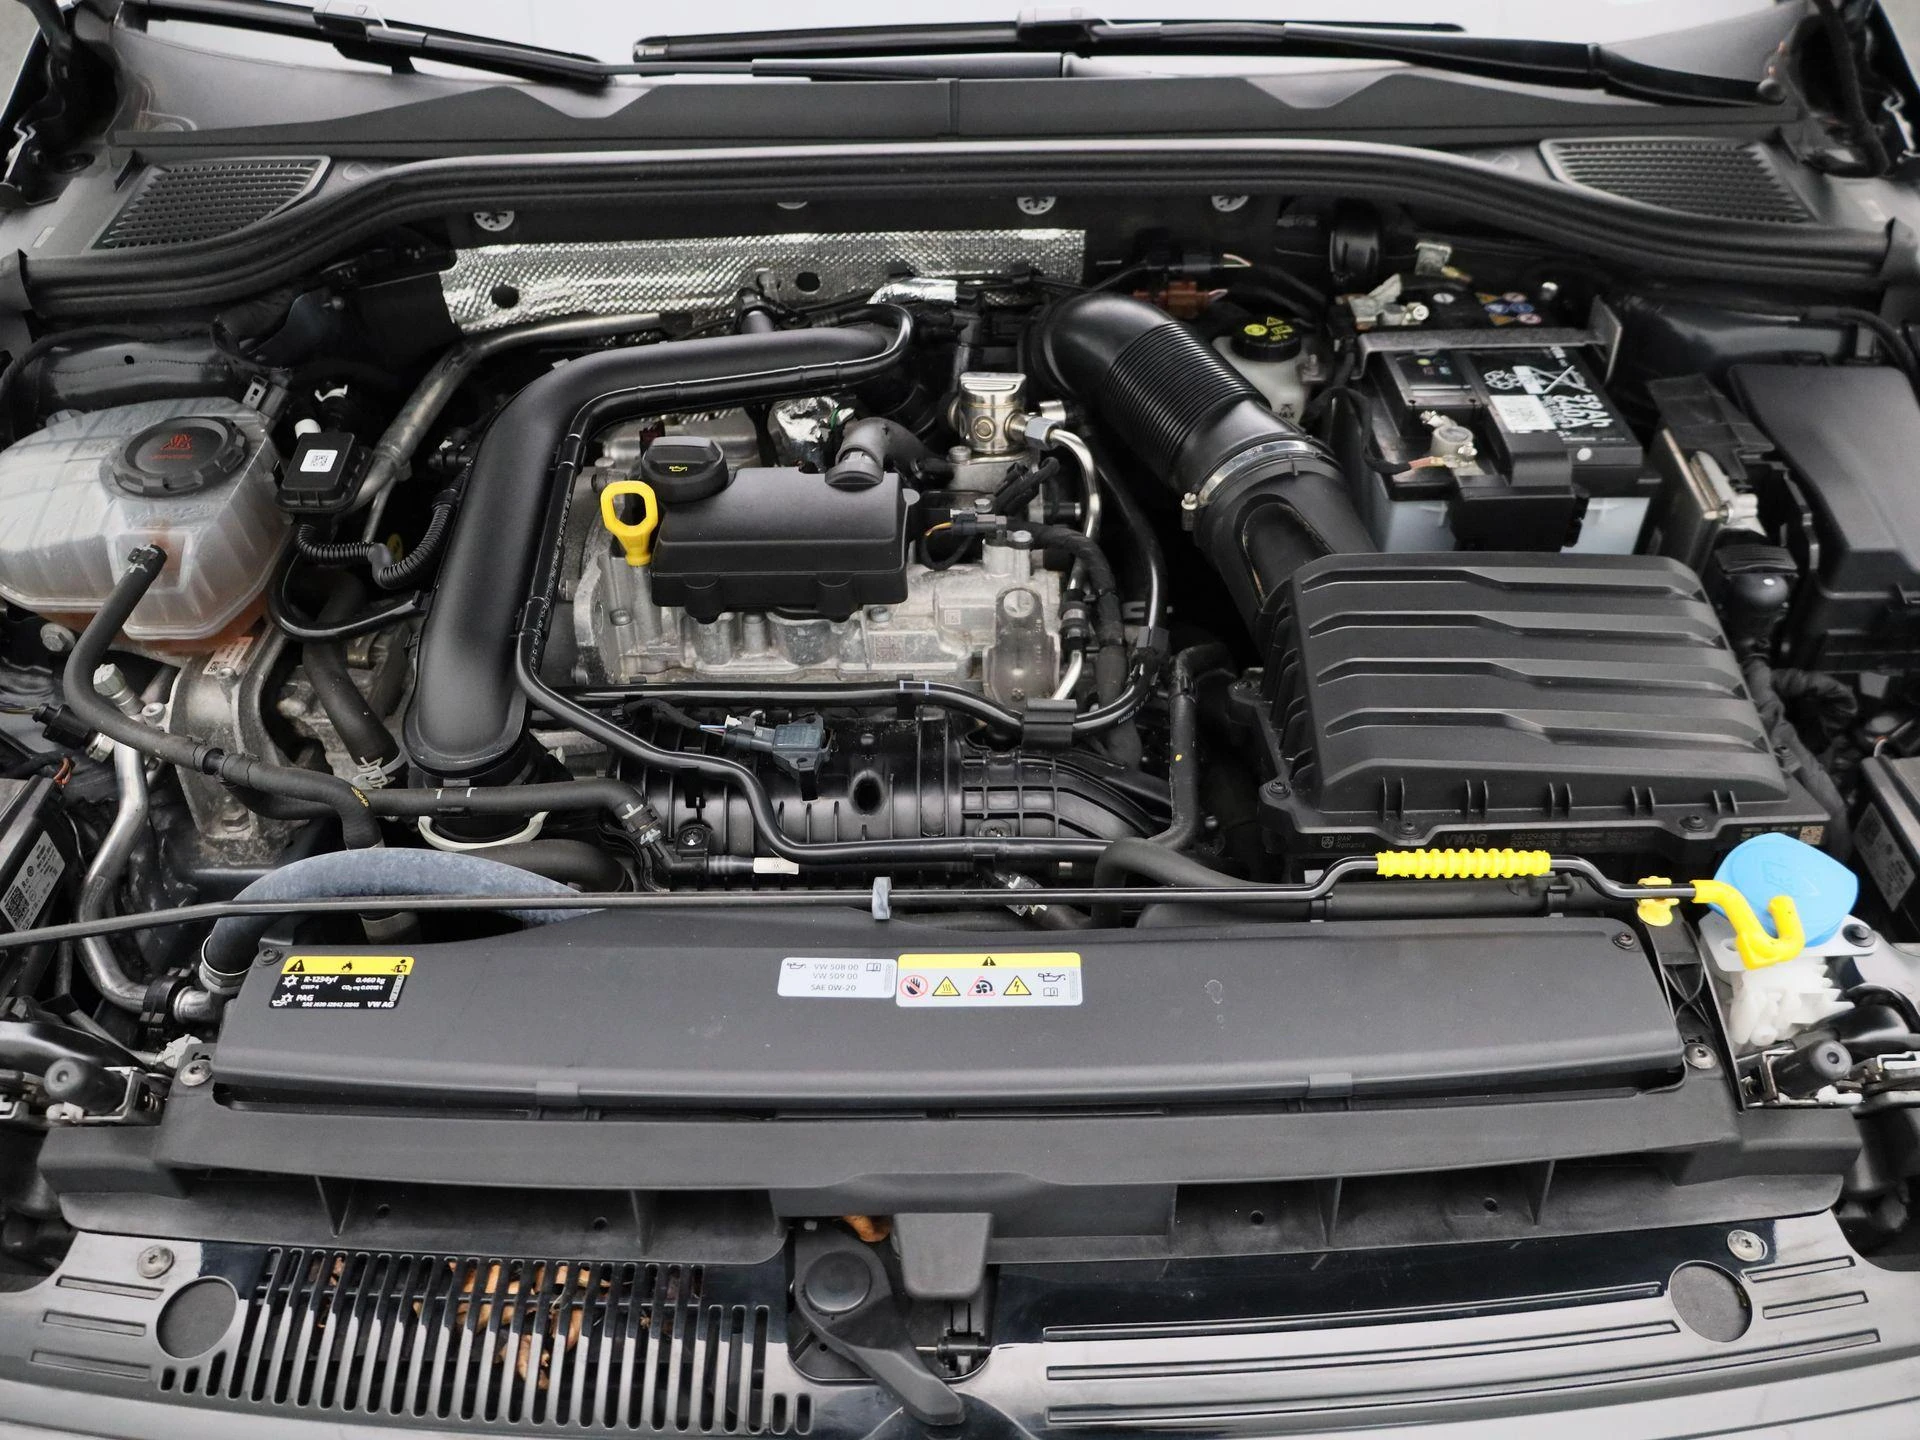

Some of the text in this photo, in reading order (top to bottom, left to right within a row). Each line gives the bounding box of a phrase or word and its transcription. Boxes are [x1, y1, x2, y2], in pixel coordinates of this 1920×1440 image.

[1574, 394, 1614, 428] 59Ah
[813, 963, 828, 971] VW
[847, 963, 859, 971] 00
[829, 972, 846, 980] 509
[810, 984, 826, 992] SAE
[295, 994, 315, 1002] PAG
